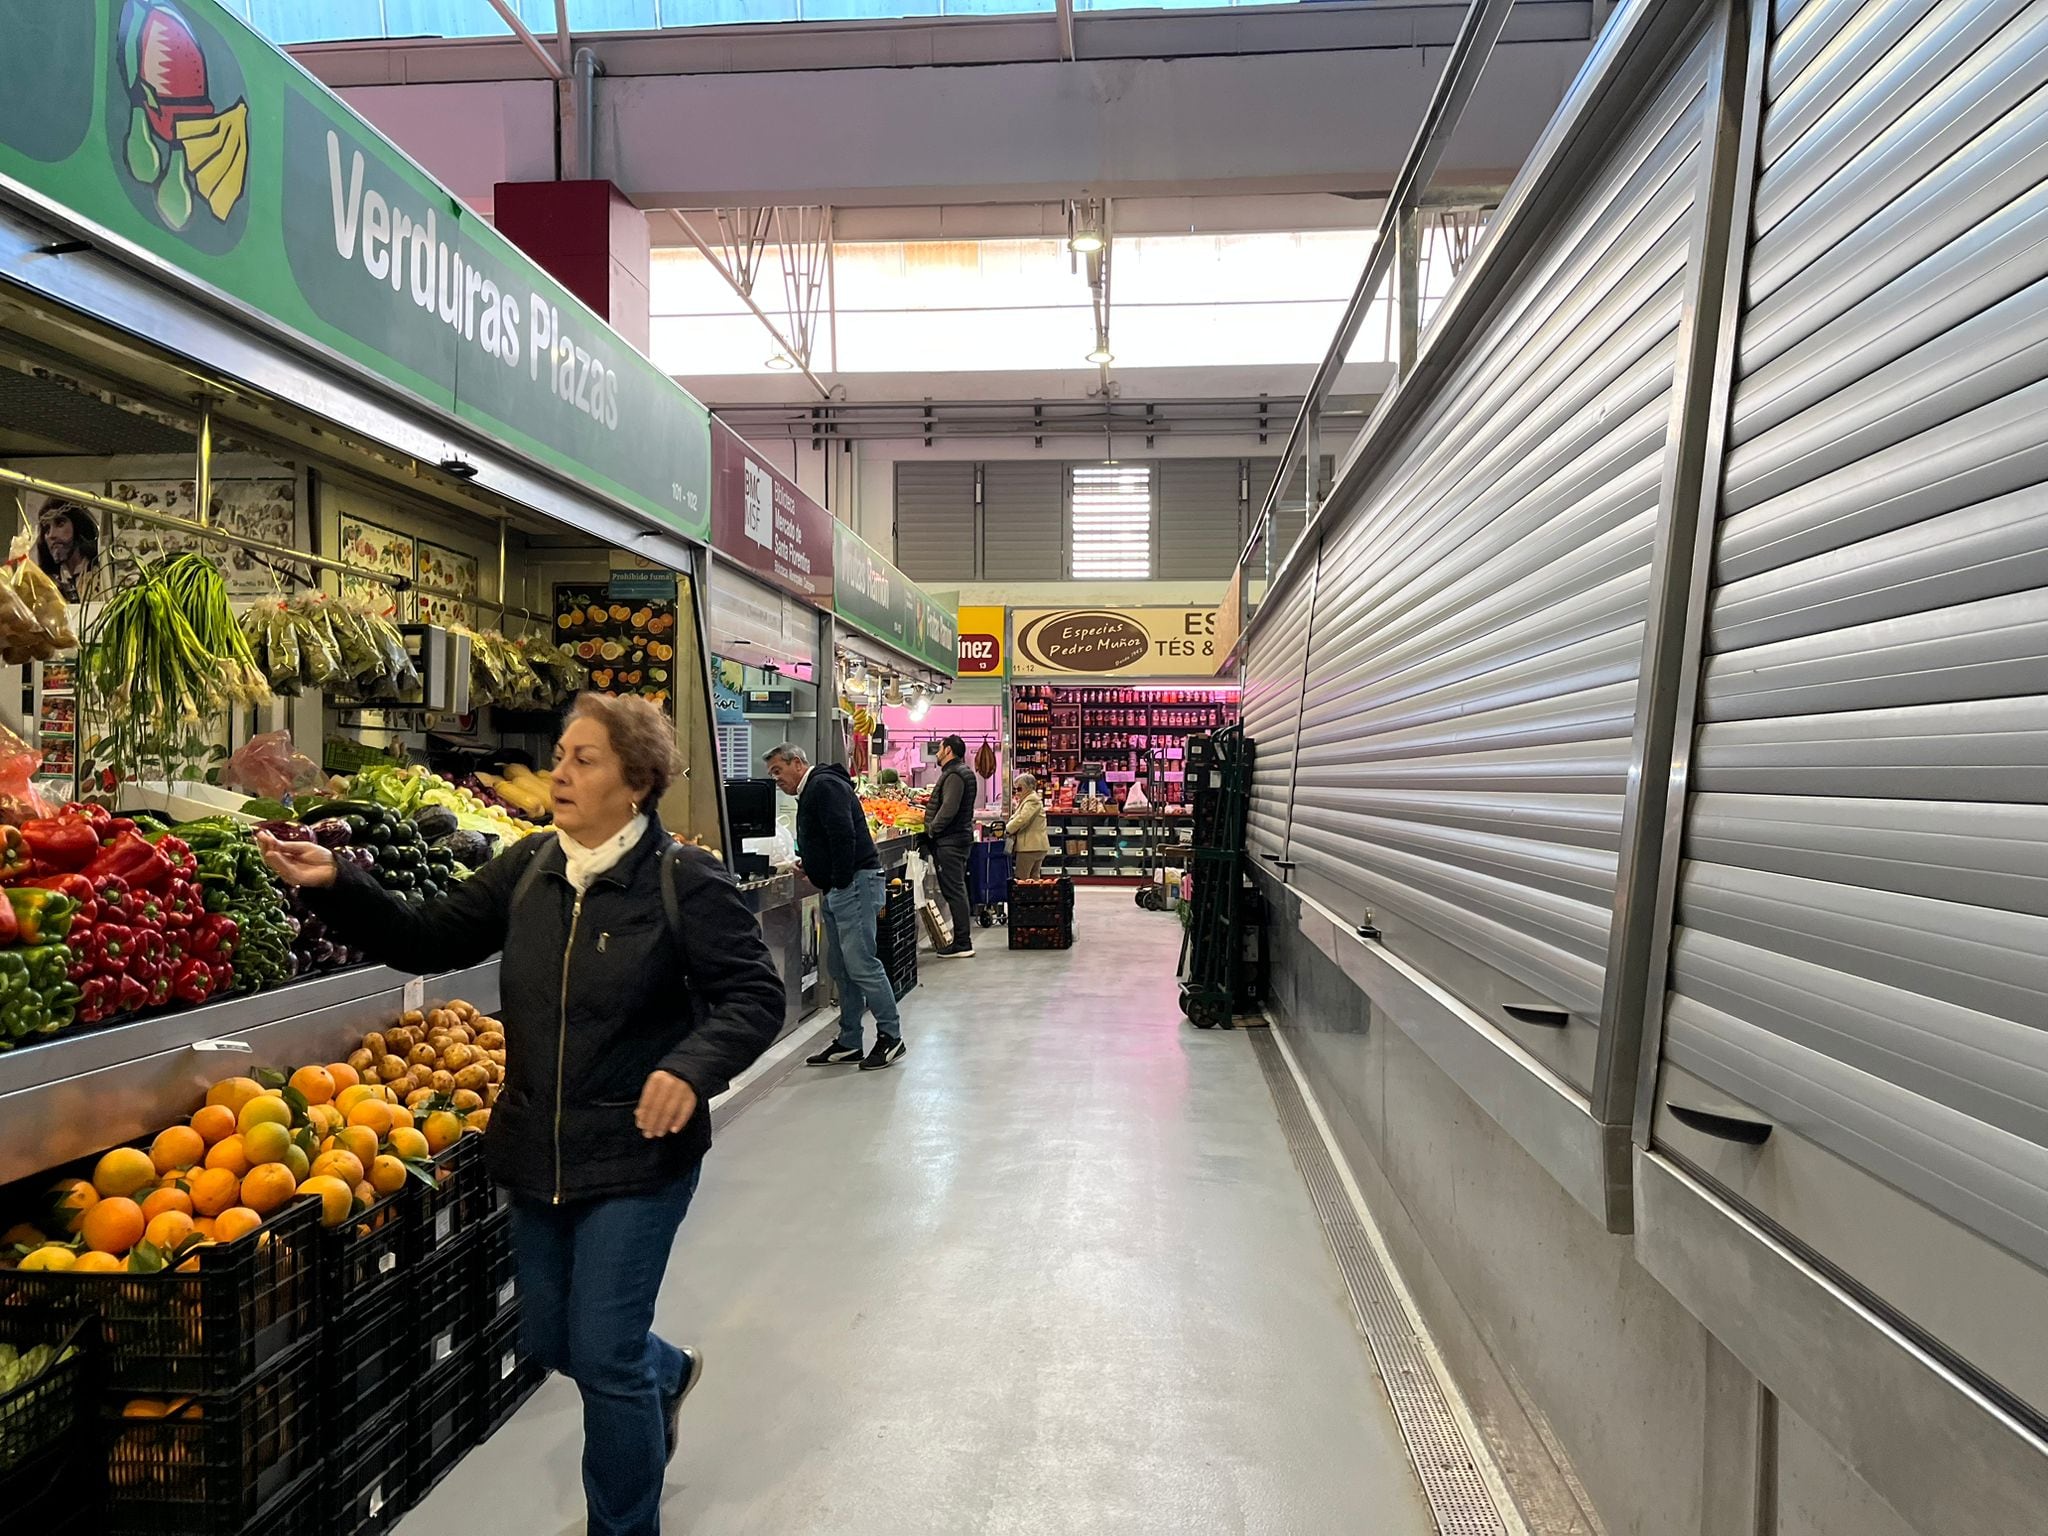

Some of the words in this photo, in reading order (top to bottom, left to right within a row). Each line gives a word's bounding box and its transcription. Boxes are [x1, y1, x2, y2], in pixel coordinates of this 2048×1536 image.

[327, 129, 520, 367] Verduras
[530, 292, 618, 430] Plazas
[671, 482, 682, 503] 101
[686, 490, 698, 512] 102
[745, 468, 760, 505] BMC
[774, 480, 796, 515] Biblioteca
[774, 506, 796, 540] Mercado
[795, 522, 802, 545] de
[774, 532, 789, 561] Santa
[789, 542, 811, 574] Florentina
[612, 571, 649, 581] Prohibido
[866, 556, 889, 610] Ramón
[1049, 643, 1093, 657] Pedro
[1097, 637, 1142, 651] Muñoz
[1062, 622, 1124, 640] Especias
[1155, 636, 1195, 657] TÉS
[1202, 640, 1214, 656] &
[1012, 664, 1021, 672] 11
[1026, 663, 1035, 672] 12
